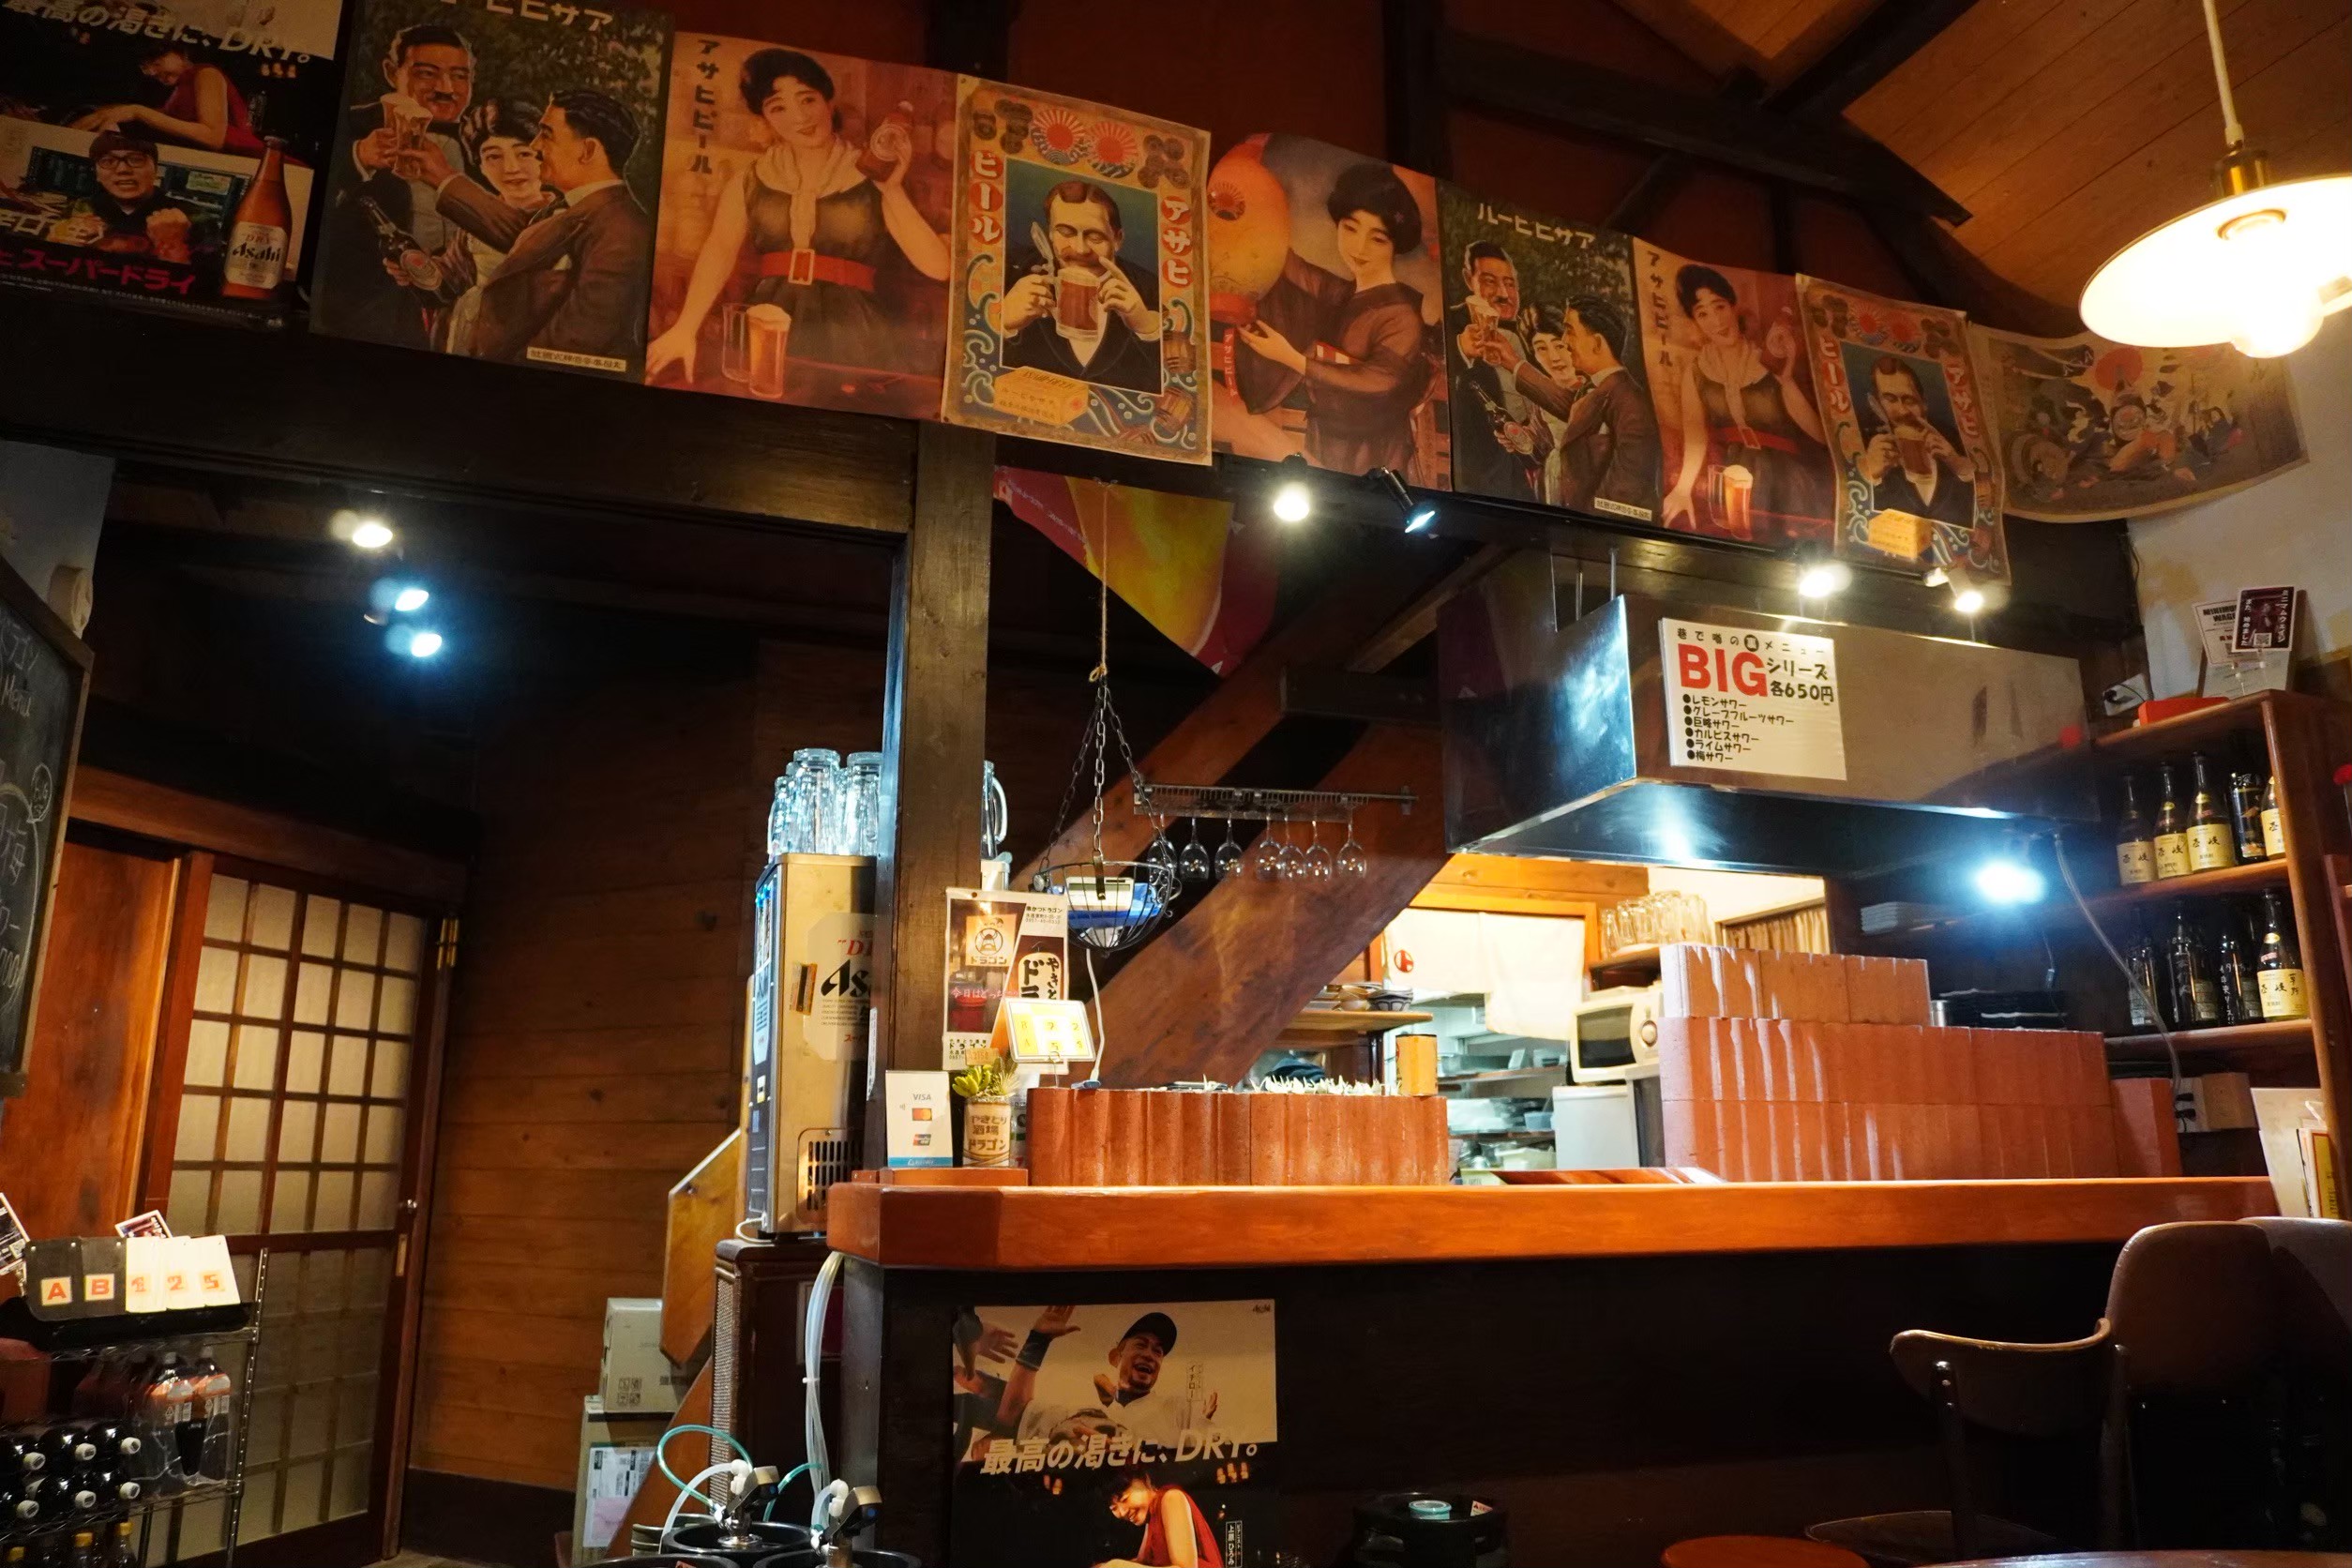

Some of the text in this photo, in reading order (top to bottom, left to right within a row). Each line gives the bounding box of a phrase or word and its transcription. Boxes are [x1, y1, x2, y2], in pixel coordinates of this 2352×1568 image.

[688, 39, 720, 174] アサヒビール
[972, 152, 1001, 242] ビール
[232, 242, 281, 262] Asahi
[1164, 200, 1191, 285] アサヒ
[1648, 250, 1673, 367] アサヒビール
[1678, 643, 1828, 697] BIG シリーズ
[1771, 680, 1834, 703] 各650円
[1693, 695, 1747, 710] レモンサワー
[1693, 706, 1794, 725] グレープフルーツサワー
[1696, 739, 1752, 753] ライムサワー
[1696, 749, 1733, 762] 梅サワー
[972, 1114, 1007, 1125] やきとり
[968, 1138, 1007, 1152] ドラゴン
[91, 1278, 110, 1295] B
[167, 1275, 183, 1291] 2
[204, 1274, 219, 1289] 5
[47, 1282, 67, 1301] A
[980, 1428, 1259, 1476] 最高の渇きに、DRY。
